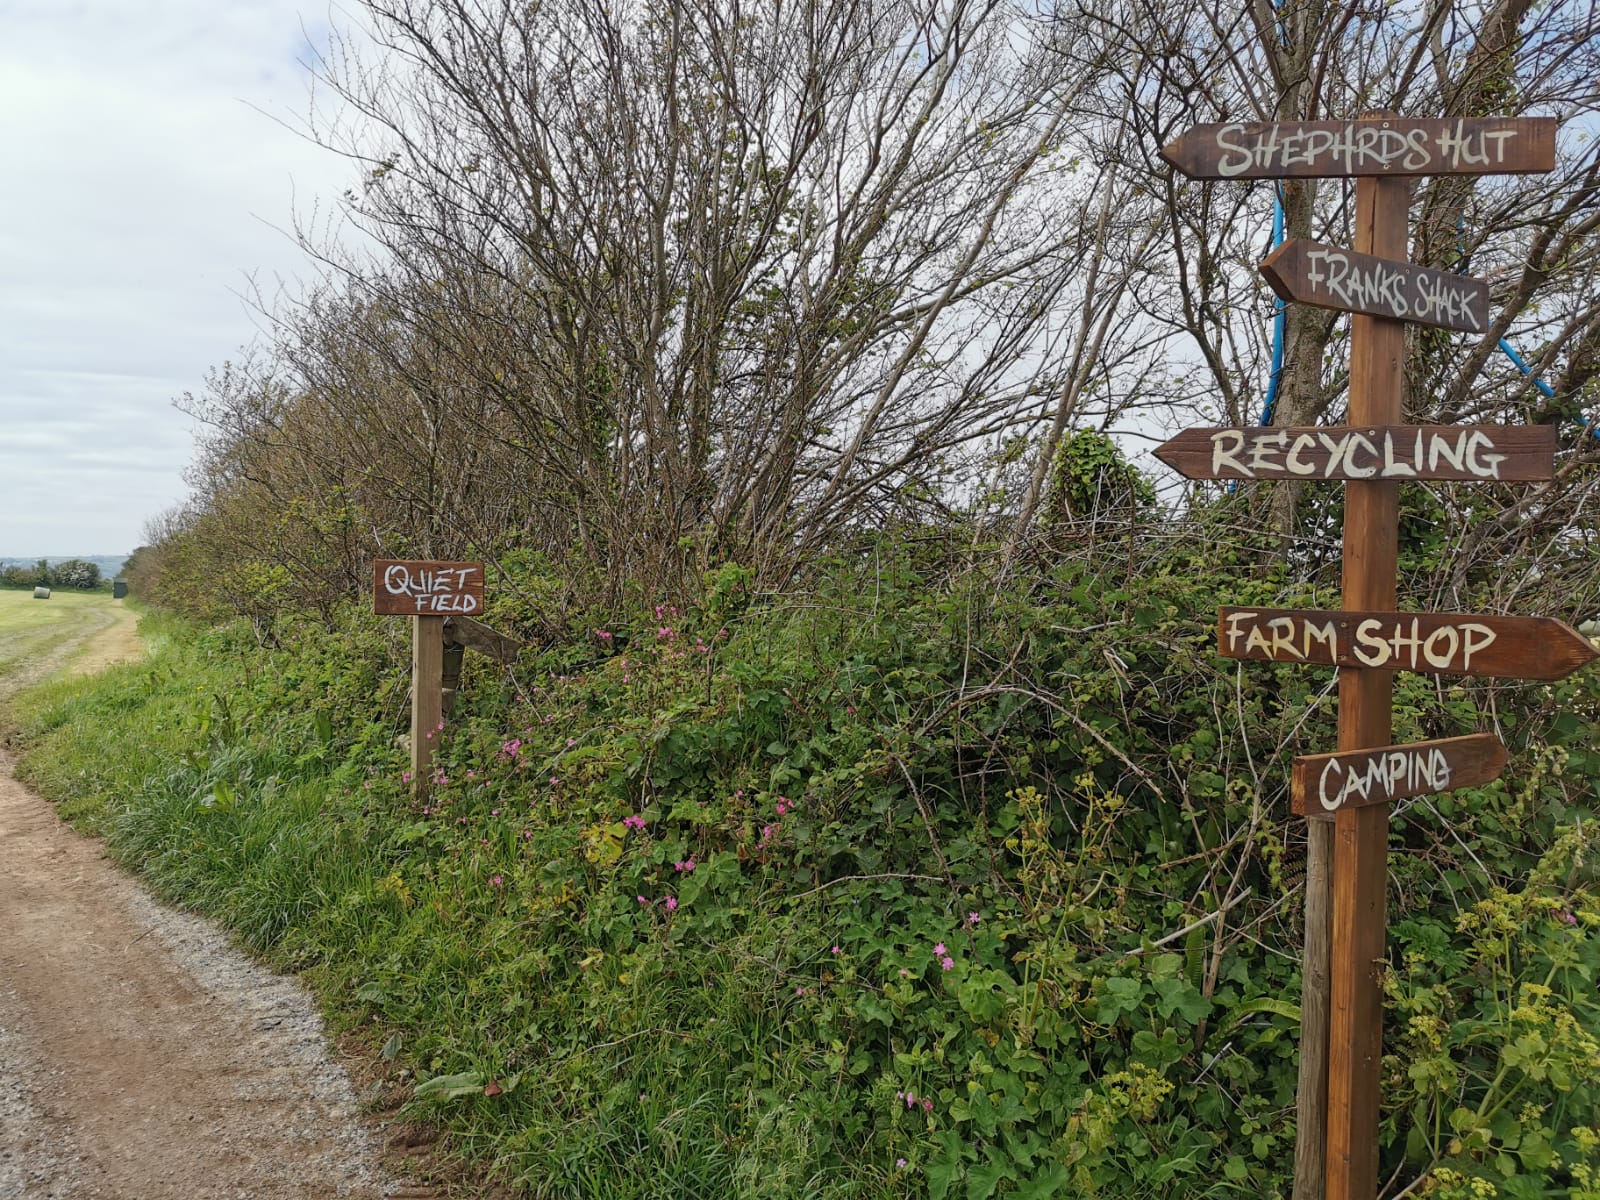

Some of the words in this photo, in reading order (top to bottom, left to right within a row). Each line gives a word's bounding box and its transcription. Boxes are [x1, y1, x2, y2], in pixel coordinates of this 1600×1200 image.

[1216, 124, 1431, 177] SHEPHRDS
[1435, 119, 1518, 169] HUT
[1307, 249, 1410, 316] FRANKS
[1414, 274, 1481, 330] SHACK
[1210, 429, 1509, 479] RECYCLING
[384, 564, 478, 597] QUIET
[415, 594, 477, 613] FIELD
[1225, 612, 1338, 665] FARM
[1353, 616, 1497, 671] SHOP
[1319, 748, 1451, 811] CAMPING
